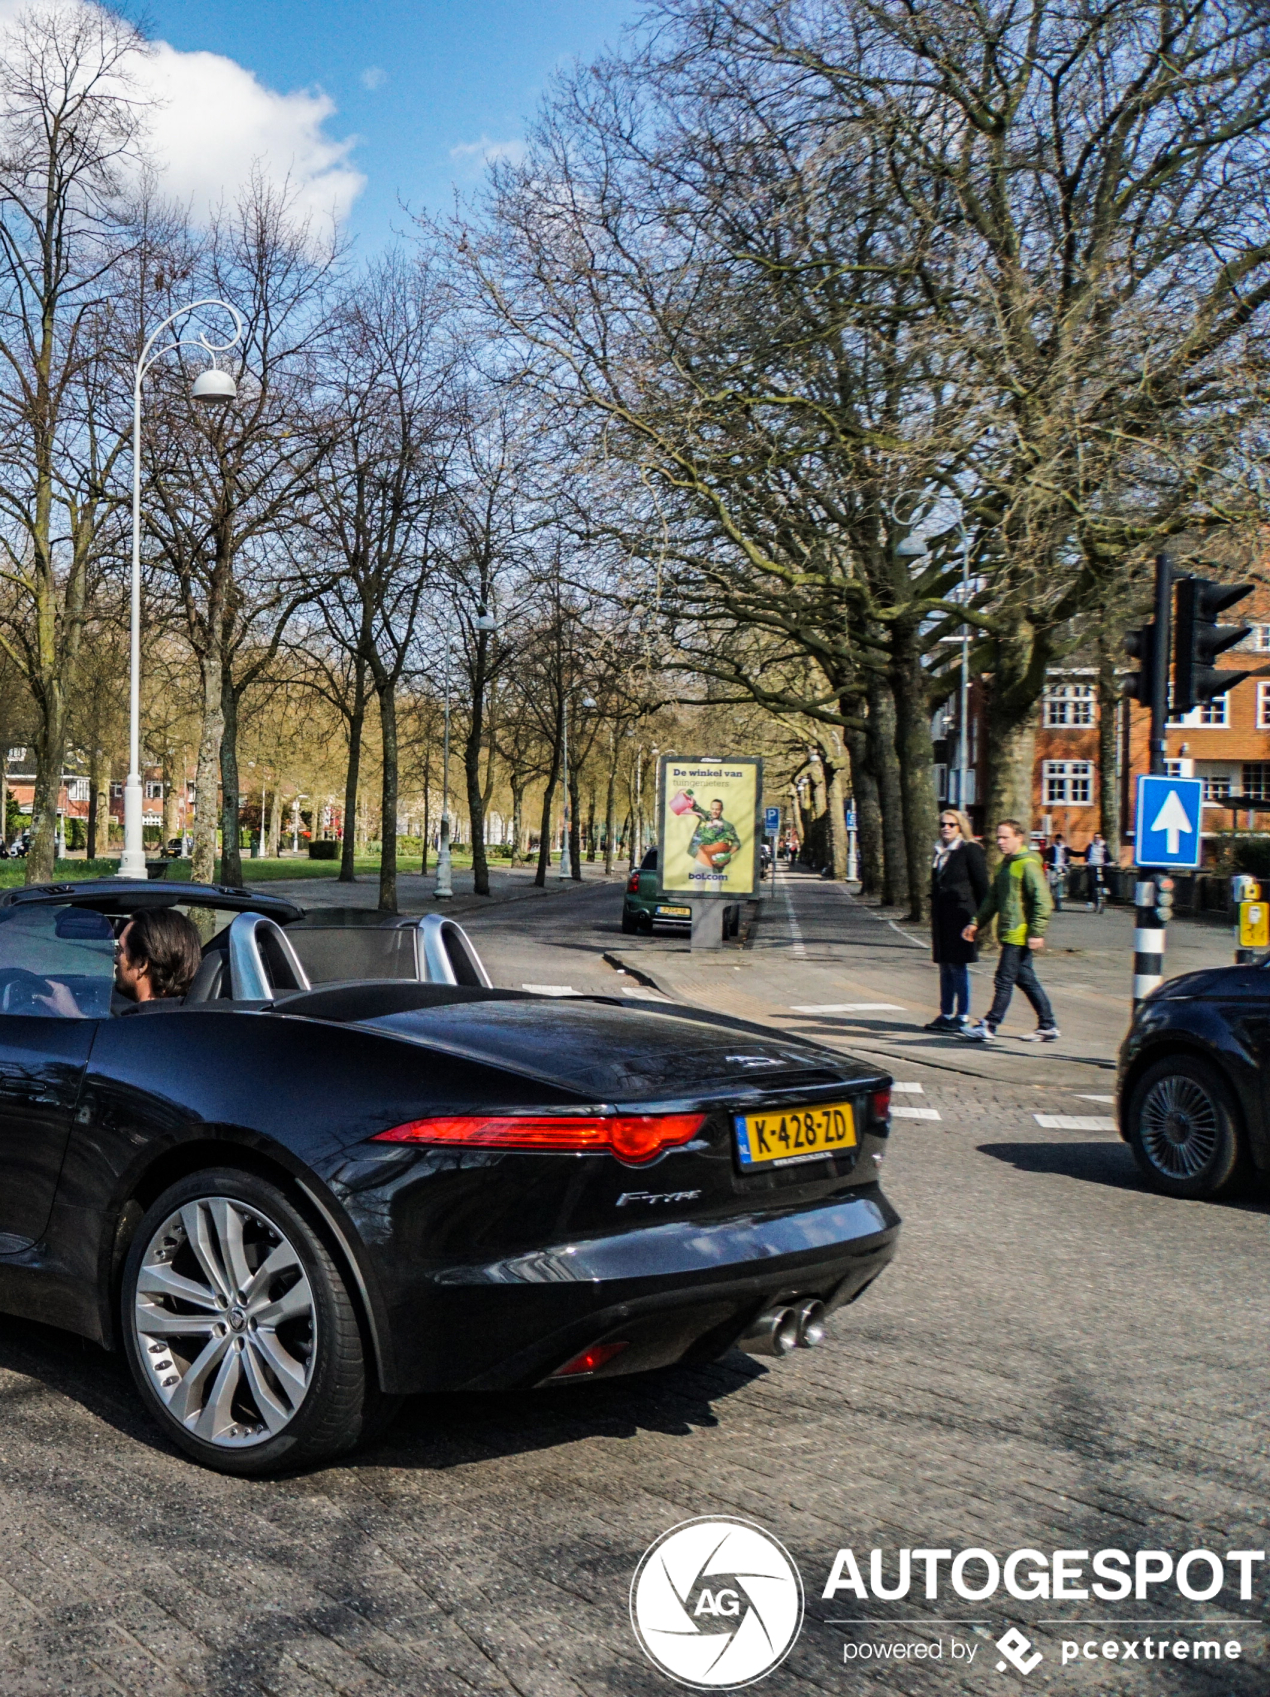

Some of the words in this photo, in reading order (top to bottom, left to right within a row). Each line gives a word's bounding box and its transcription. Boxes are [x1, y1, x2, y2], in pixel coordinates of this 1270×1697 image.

[673, 769, 687, 777] De
[689, 769, 723, 778] winkel
[768, 809, 776, 820] P
[755, 1109, 847, 1155] K-428-ZD
